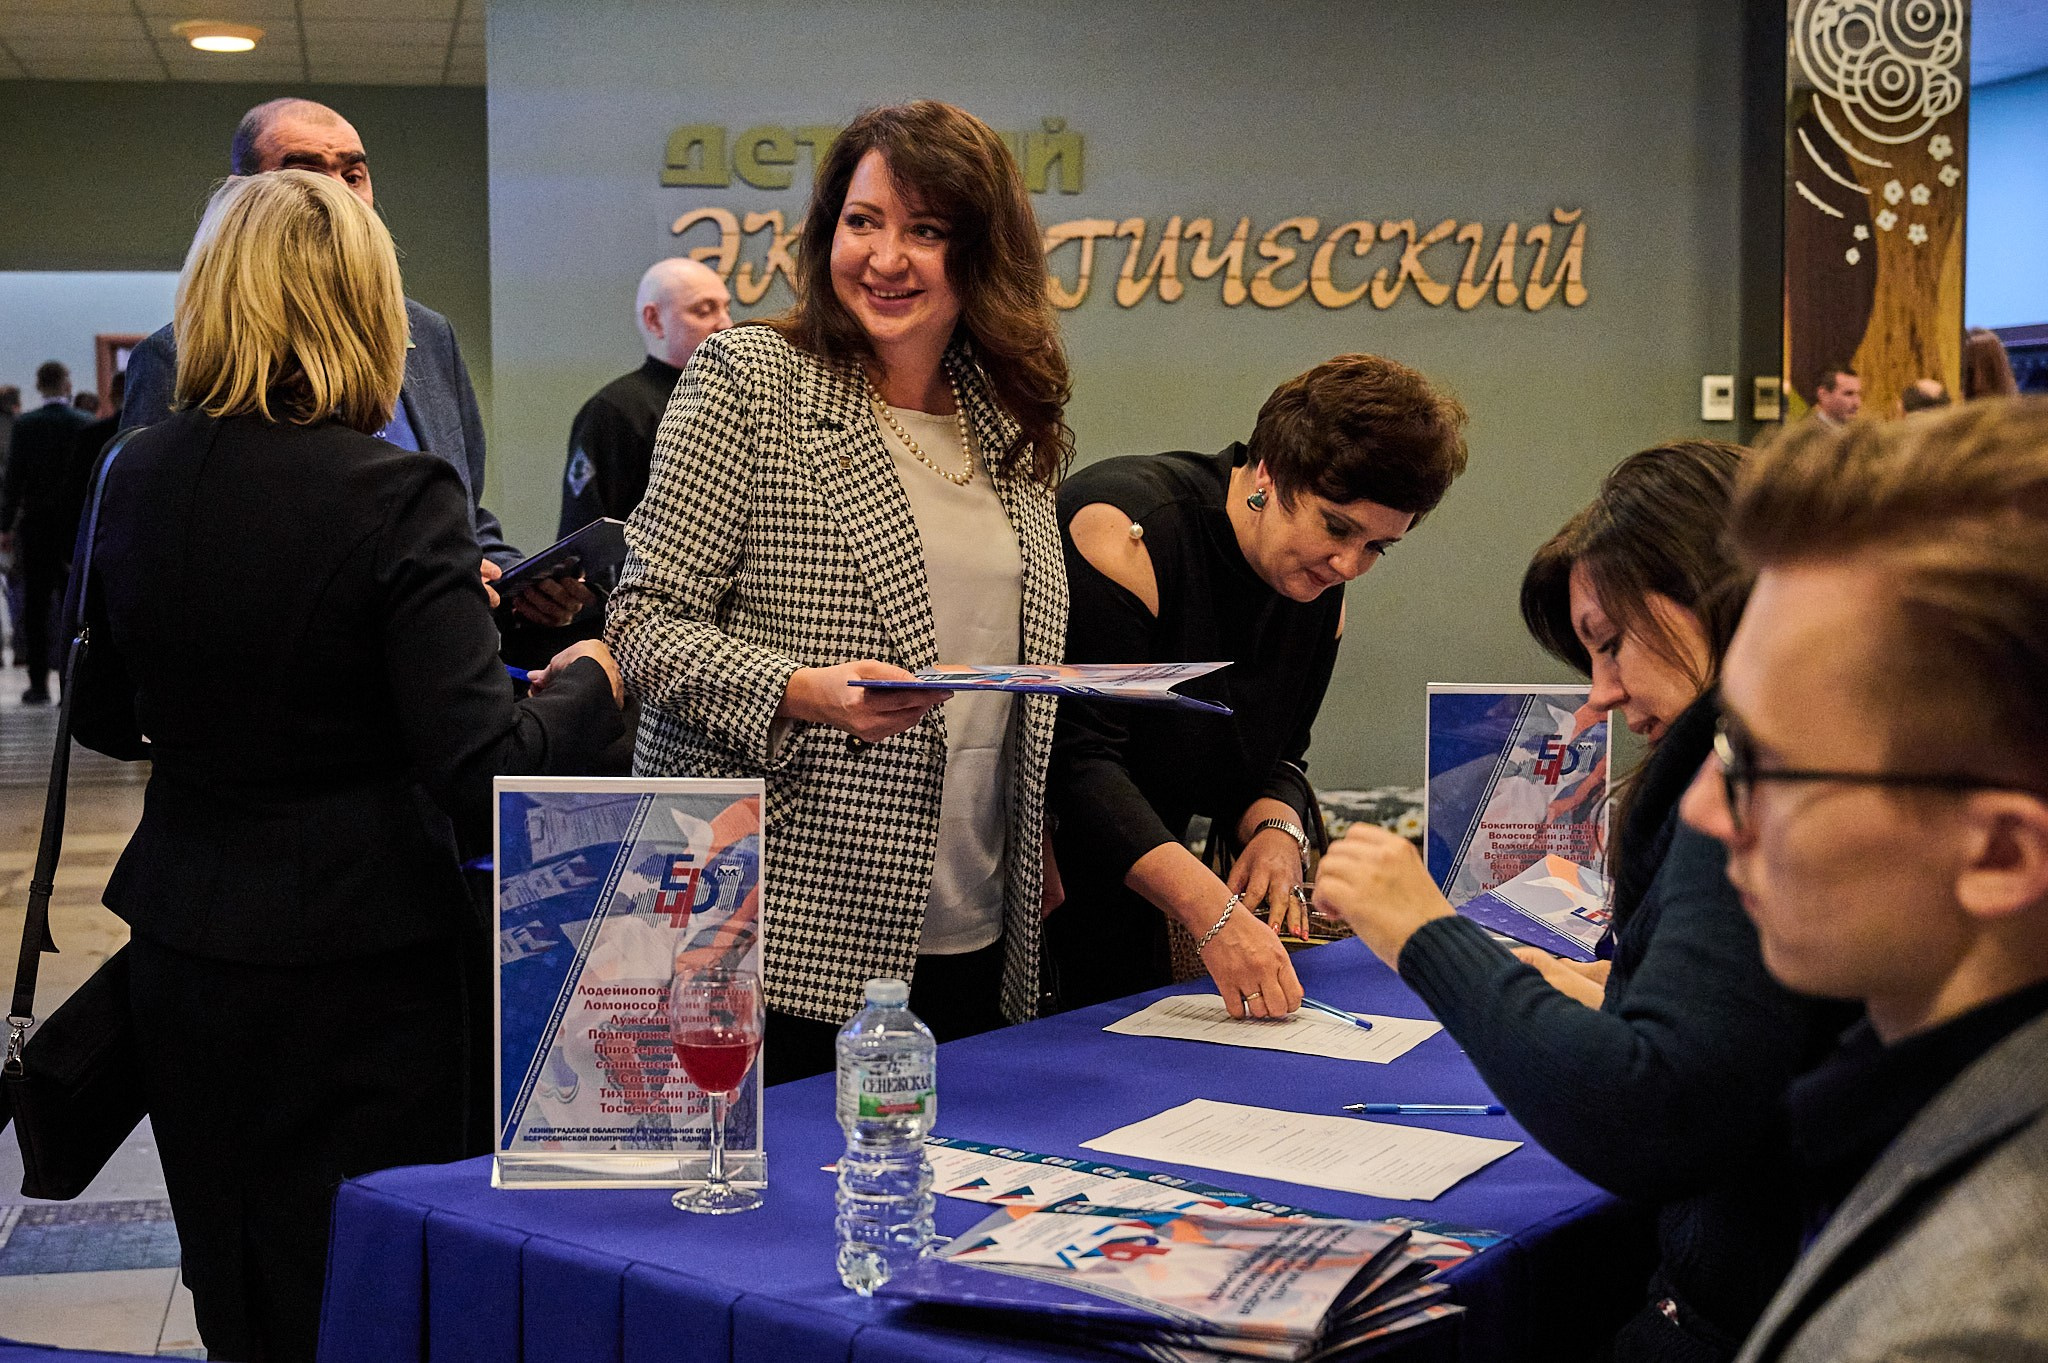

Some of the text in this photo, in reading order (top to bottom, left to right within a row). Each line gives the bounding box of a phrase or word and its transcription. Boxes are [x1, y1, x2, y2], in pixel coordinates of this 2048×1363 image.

[660, 116, 1084, 194] детий
[1488, 831, 1557, 841] Волосовский
[1491, 841, 1554, 851] Волховский
